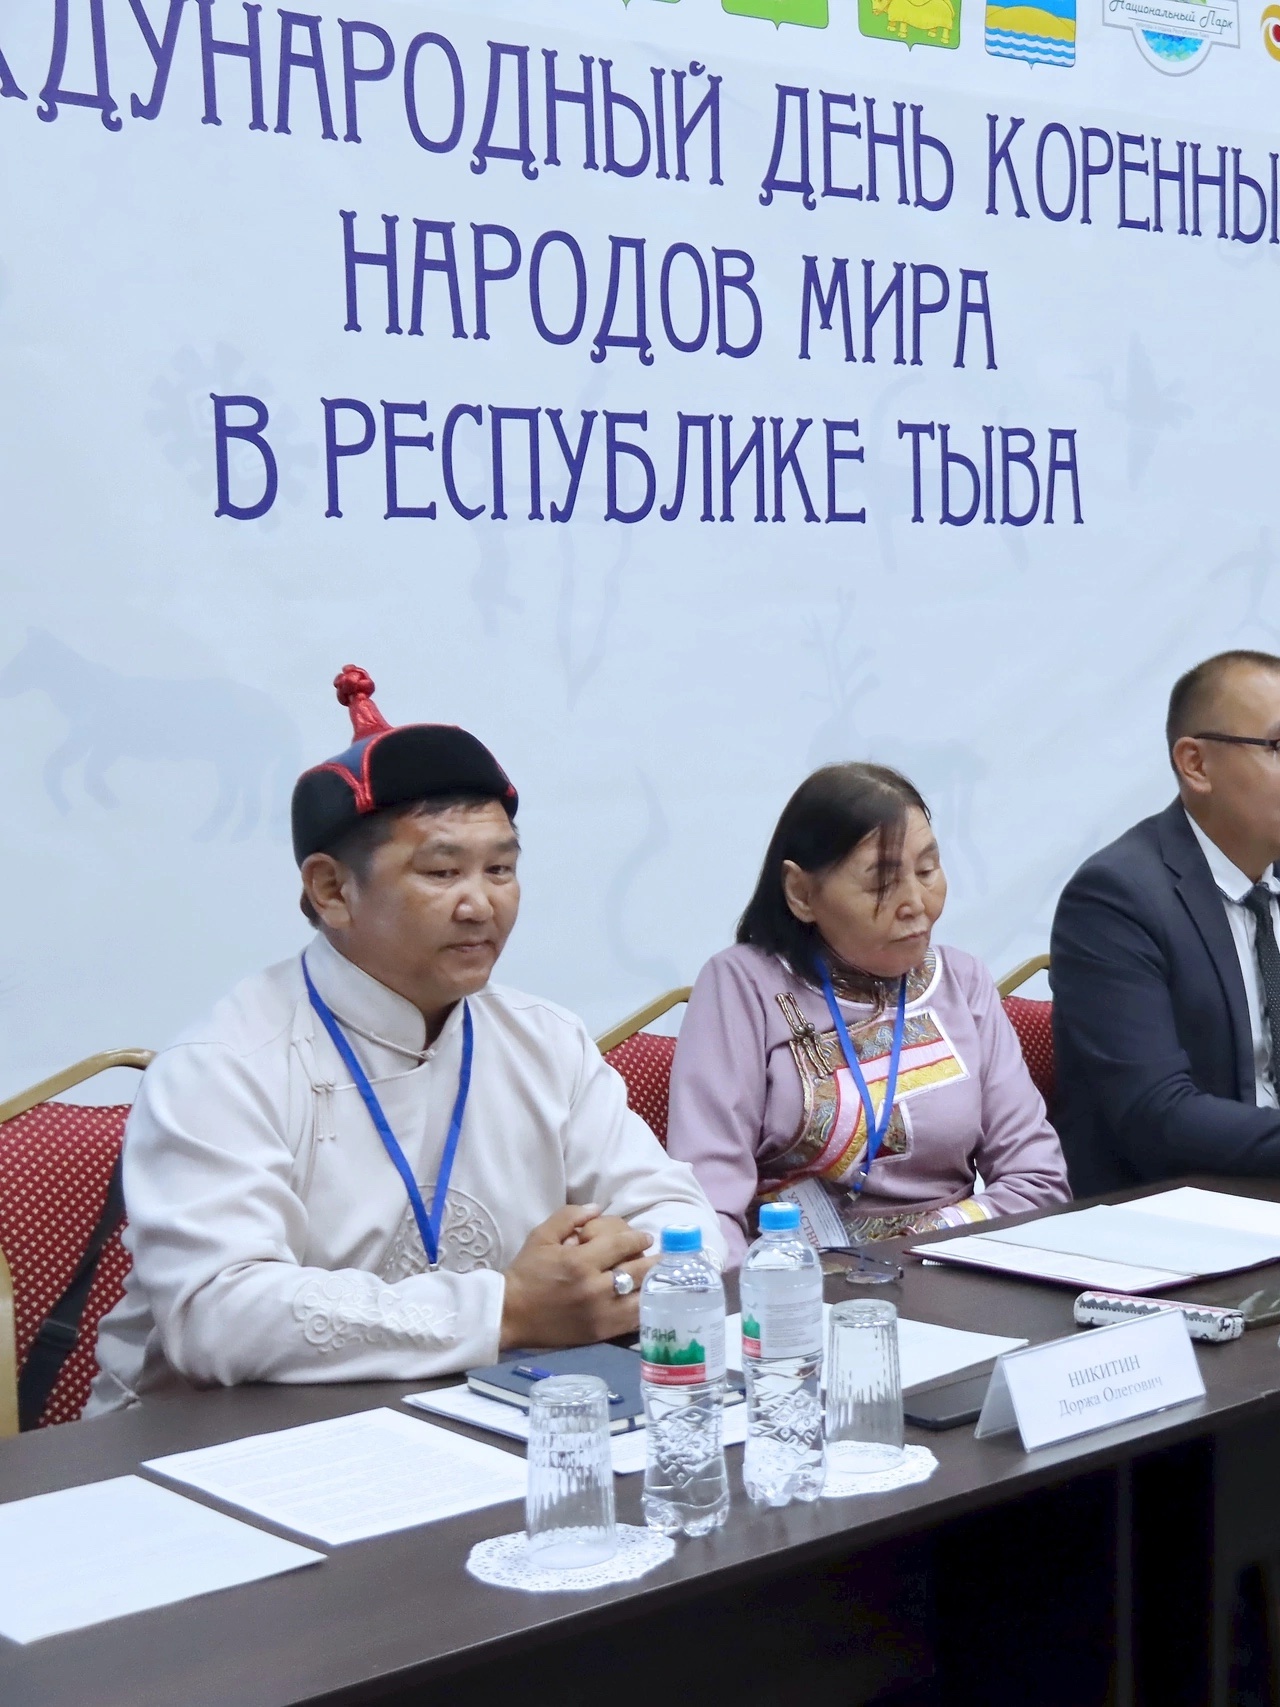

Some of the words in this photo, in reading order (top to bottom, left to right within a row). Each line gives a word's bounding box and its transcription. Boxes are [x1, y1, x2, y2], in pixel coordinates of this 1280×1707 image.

[1108, 0, 1196, 23] Национальный
[1199, 10, 1233, 34] Парк
[759, 83, 955, 211] ДЕНЬ
[339, 210, 763, 366] НАРОДОВ
[799, 255, 998, 370] МИРА
[210, 392, 278, 520] В
[321, 397, 867, 524] РЕСПУБЛИКЕ
[898, 419, 1085, 527] ТЫВА
[1059, 1393, 1101, 1418] Доржа
[1102, 1376, 1164, 1402] Олегович
[1068, 1354, 1141, 1388] НИКИТИН
